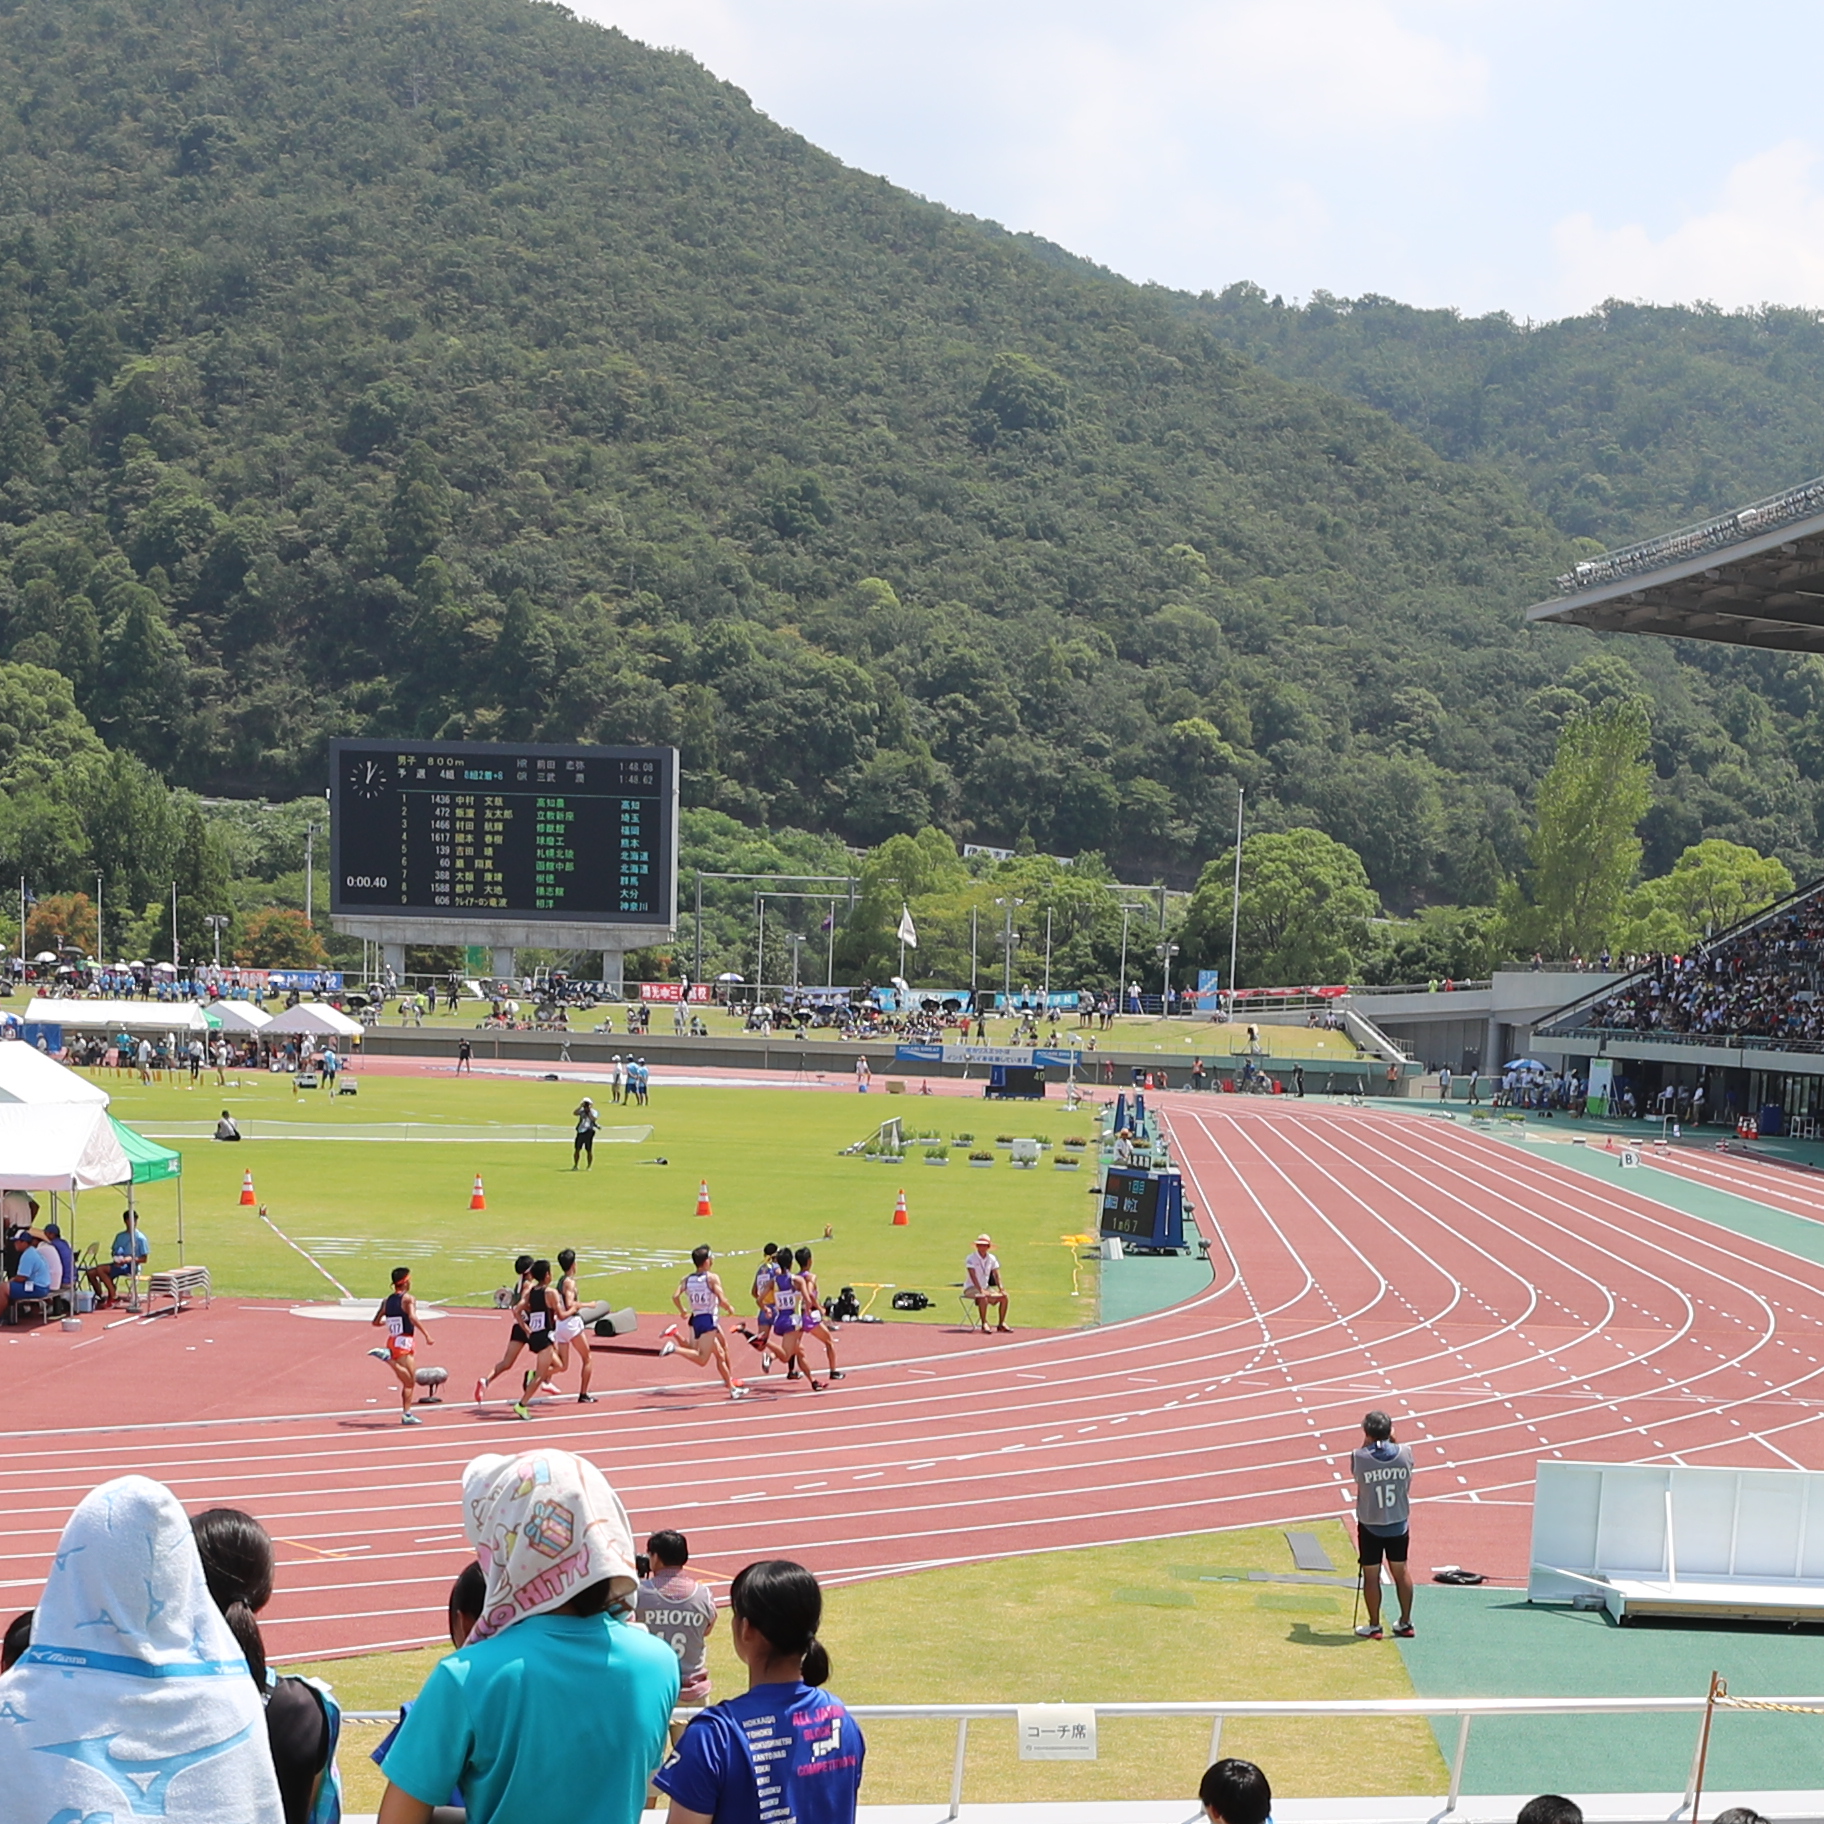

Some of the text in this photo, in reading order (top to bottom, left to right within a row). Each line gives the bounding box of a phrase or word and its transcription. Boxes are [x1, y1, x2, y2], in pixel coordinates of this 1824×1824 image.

[397, 755, 417, 767] 男子
[427, 757, 465, 767] 800m
[537, 760, 556, 770] 前田
[619, 762, 653, 772] 1:48.08
[439, 769, 455, 780] 4組
[619, 774, 653, 785] 1:48.62
[401, 794, 407, 804] 1
[431, 795, 451, 805] 1436
[455, 795, 474, 806] 中村
[620, 800, 640, 810] 高知
[401, 807, 407, 817] 2
[435, 807, 451, 817] 472
[620, 813, 640, 823] 埼玉
[401, 819, 407, 829] 3
[431, 820, 451, 830] 1466
[455, 821, 474, 831] 村田
[620, 825, 640, 835] 福岡
[401, 831, 407, 841] 4
[431, 832, 451, 843] 1617
[620, 838, 640, 849] 熊本
[401, 844, 407, 854] 5
[436, 845, 451, 856] 139
[455, 846, 474, 857] 吉田
[620, 851, 649, 861] 北海道
[401, 856, 649, 875] 6 60 函館中部 北海道
[346, 876, 388, 889] 0:00.40
[401, 869, 407, 879] 7
[620, 876, 639, 886] 群馬
[401, 882, 407, 892] 8
[431, 883, 451, 893] 1588
[619, 888, 639, 899] 大分
[401, 895, 407, 905] 9
[435, 896, 451, 906] 606
[619, 901, 649, 912] 神奈川
[1201, 971, 1211, 980] S1
[1033, 1071, 1046, 1081] 40
[1625, 1154, 1633, 1165] B
[777, 1296, 795, 1308] 388
[1363, 1467, 1407, 1484] PHOTO
[1375, 1484, 1397, 1509] 15
[512, 1544, 591, 1610] KITTY
[643, 1608, 704, 1627] PHOTO
[792, 1711, 813, 1727] ALL
[1027, 1723, 1087, 1740] コーチ席
[796, 1754, 857, 1778] COMPETITION
